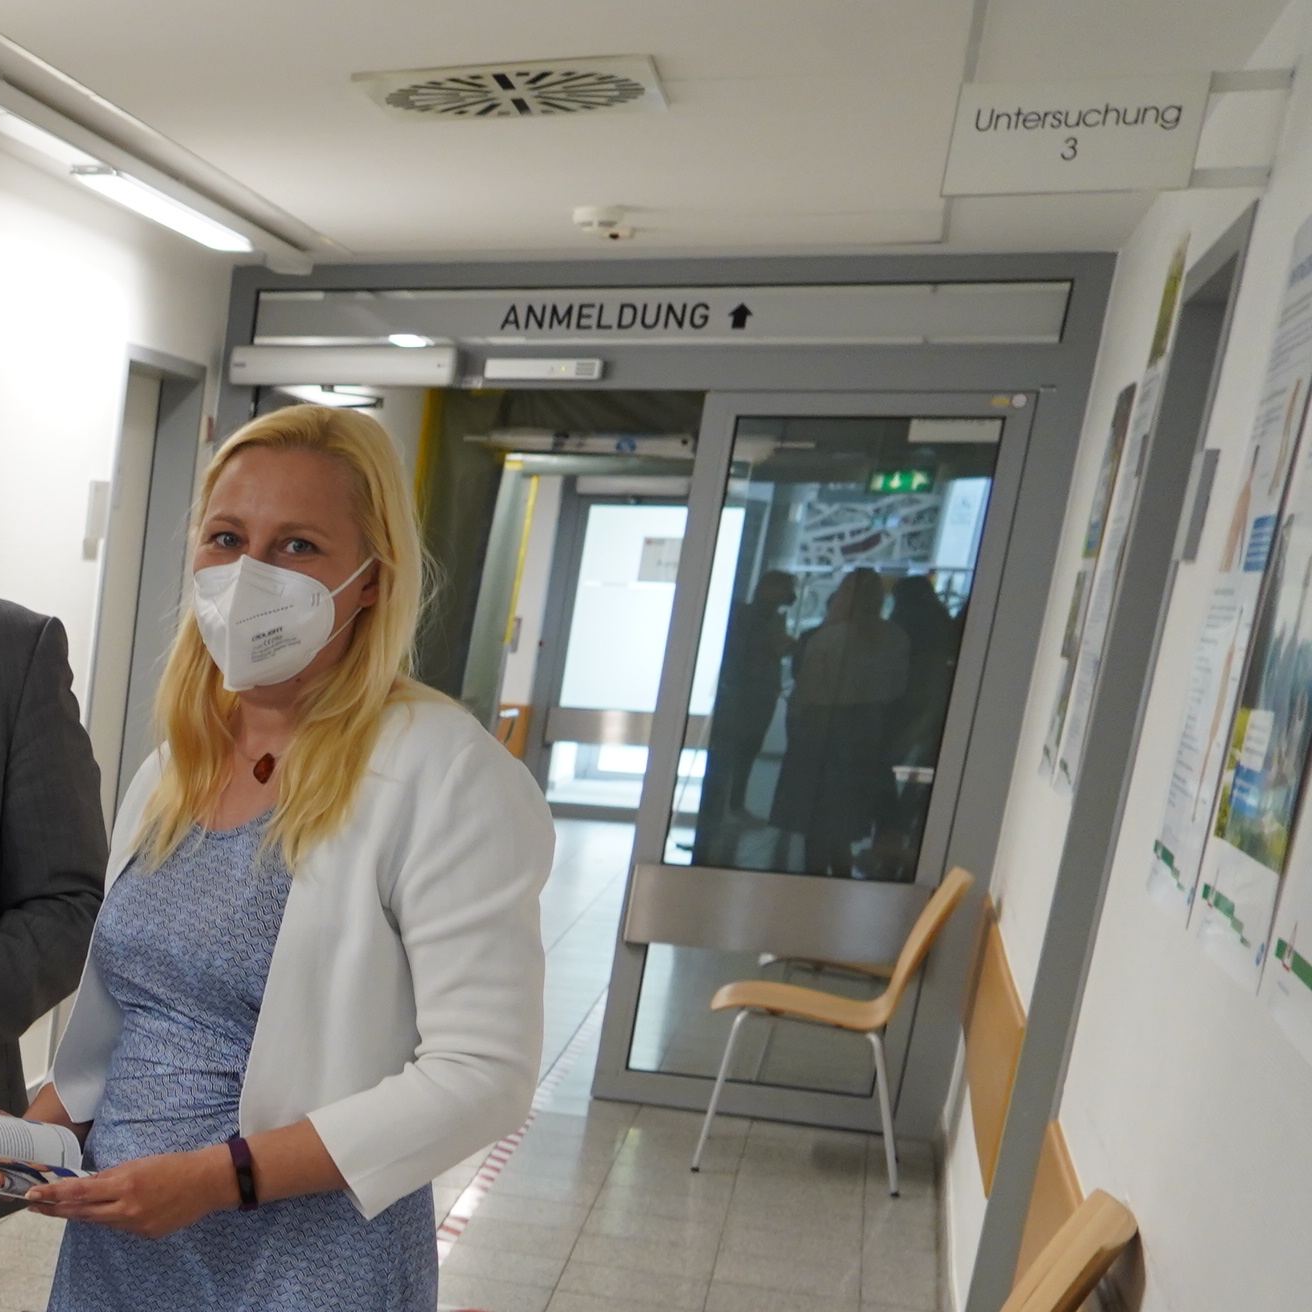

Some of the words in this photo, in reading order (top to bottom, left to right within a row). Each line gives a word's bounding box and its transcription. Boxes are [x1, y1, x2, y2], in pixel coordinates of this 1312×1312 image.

[976, 103, 1182, 132] Untersuchung
[1060, 137, 1078, 161] 3
[500, 302, 709, 330] ANMELDUNG
